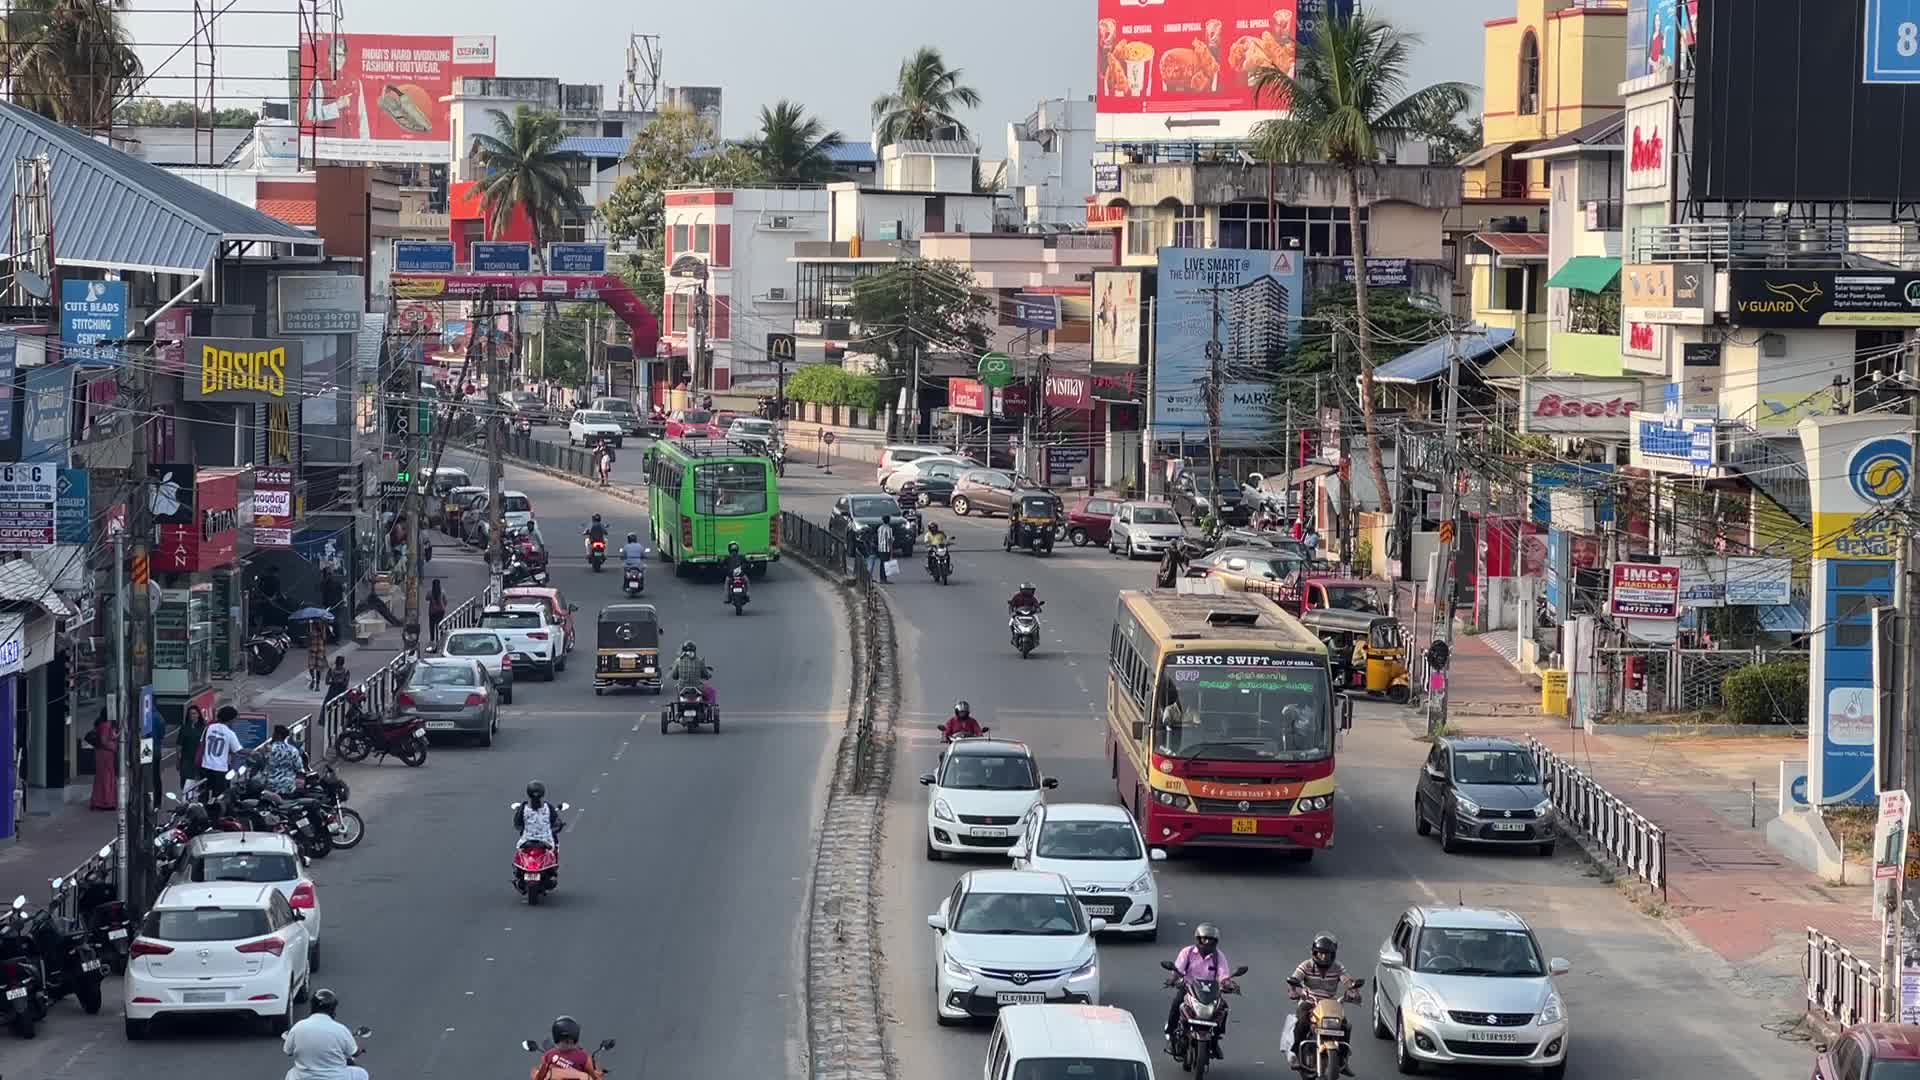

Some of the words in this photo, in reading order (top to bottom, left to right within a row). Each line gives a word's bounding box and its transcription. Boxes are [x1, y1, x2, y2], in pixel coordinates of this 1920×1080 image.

[391, 48, 411, 60] HARD
[413, 49, 450, 62] WORKING
[361, 61, 394, 73] FASHION
[1184, 257, 1205, 270] LIVE
[1207, 258, 1241, 271] SMART
[1170, 270, 1183, 281] THE
[1207, 271, 1241, 285] HEART
[64, 301, 88, 312] CUTE
[89, 302, 119, 313] BEADS
[72, 319, 112, 330] STITCHING
[202, 344, 286, 398] BASICS
[1, 528, 45, 538] aramex
[1623, 567, 1661, 582] IMC
[1618, 581, 1673, 589] PRACTICALS
[1175, 655, 1223, 665] KSRTC
[1227, 655, 1271, 665] SWIFT
[207, 735, 226, 758] 10
